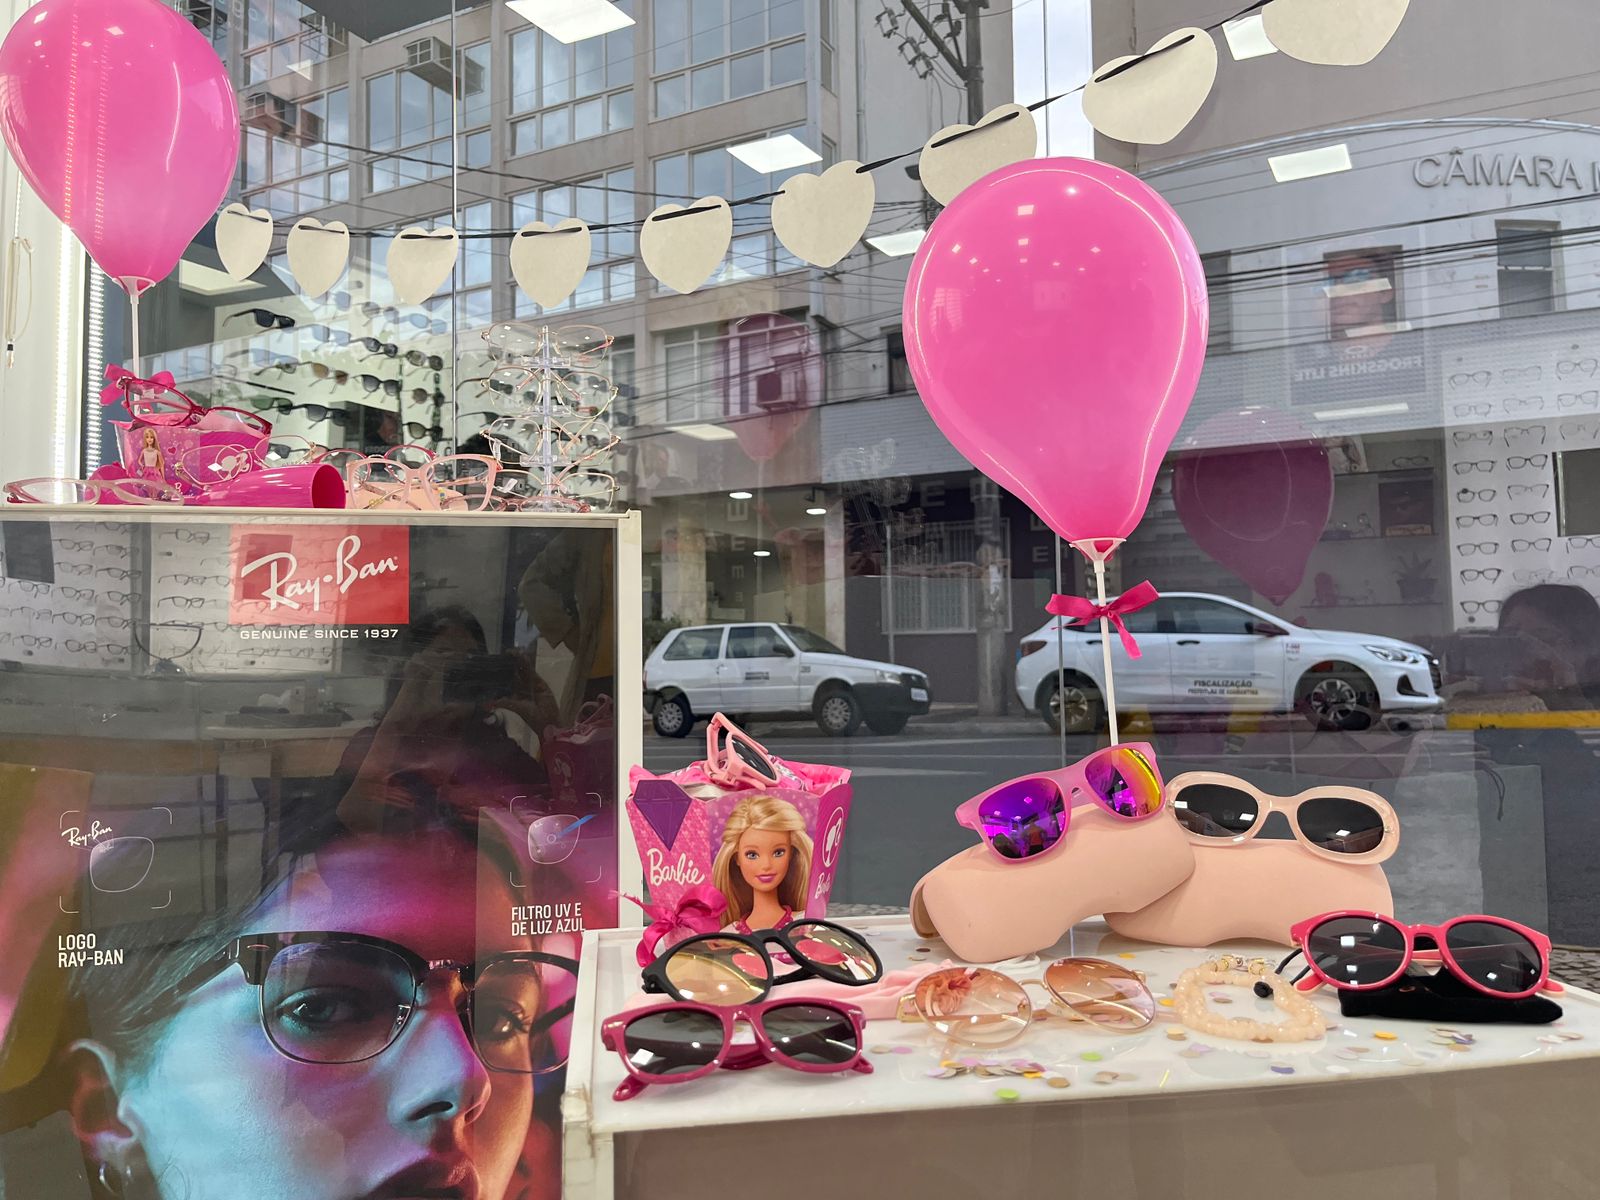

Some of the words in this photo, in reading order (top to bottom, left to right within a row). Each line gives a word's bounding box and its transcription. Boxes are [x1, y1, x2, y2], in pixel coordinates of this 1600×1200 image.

[1412, 147, 1583, 190] CÂMARA
[240, 629, 308, 640] GENUINE
[314, 629, 359, 640] SINCE
[364, 629, 399, 639] 1937
[646, 847, 706, 887] Barbie
[511, 904, 552, 921] FILTRO
[555, 903, 572, 918] UV
[574, 902, 582, 917] E
[511, 921, 527, 936] DE
[530, 919, 553, 935] LUZ
[556, 917, 585, 933] AZUL
[58, 933, 96, 951] LOGO
[58, 949, 124, 968] RAY-BAN
